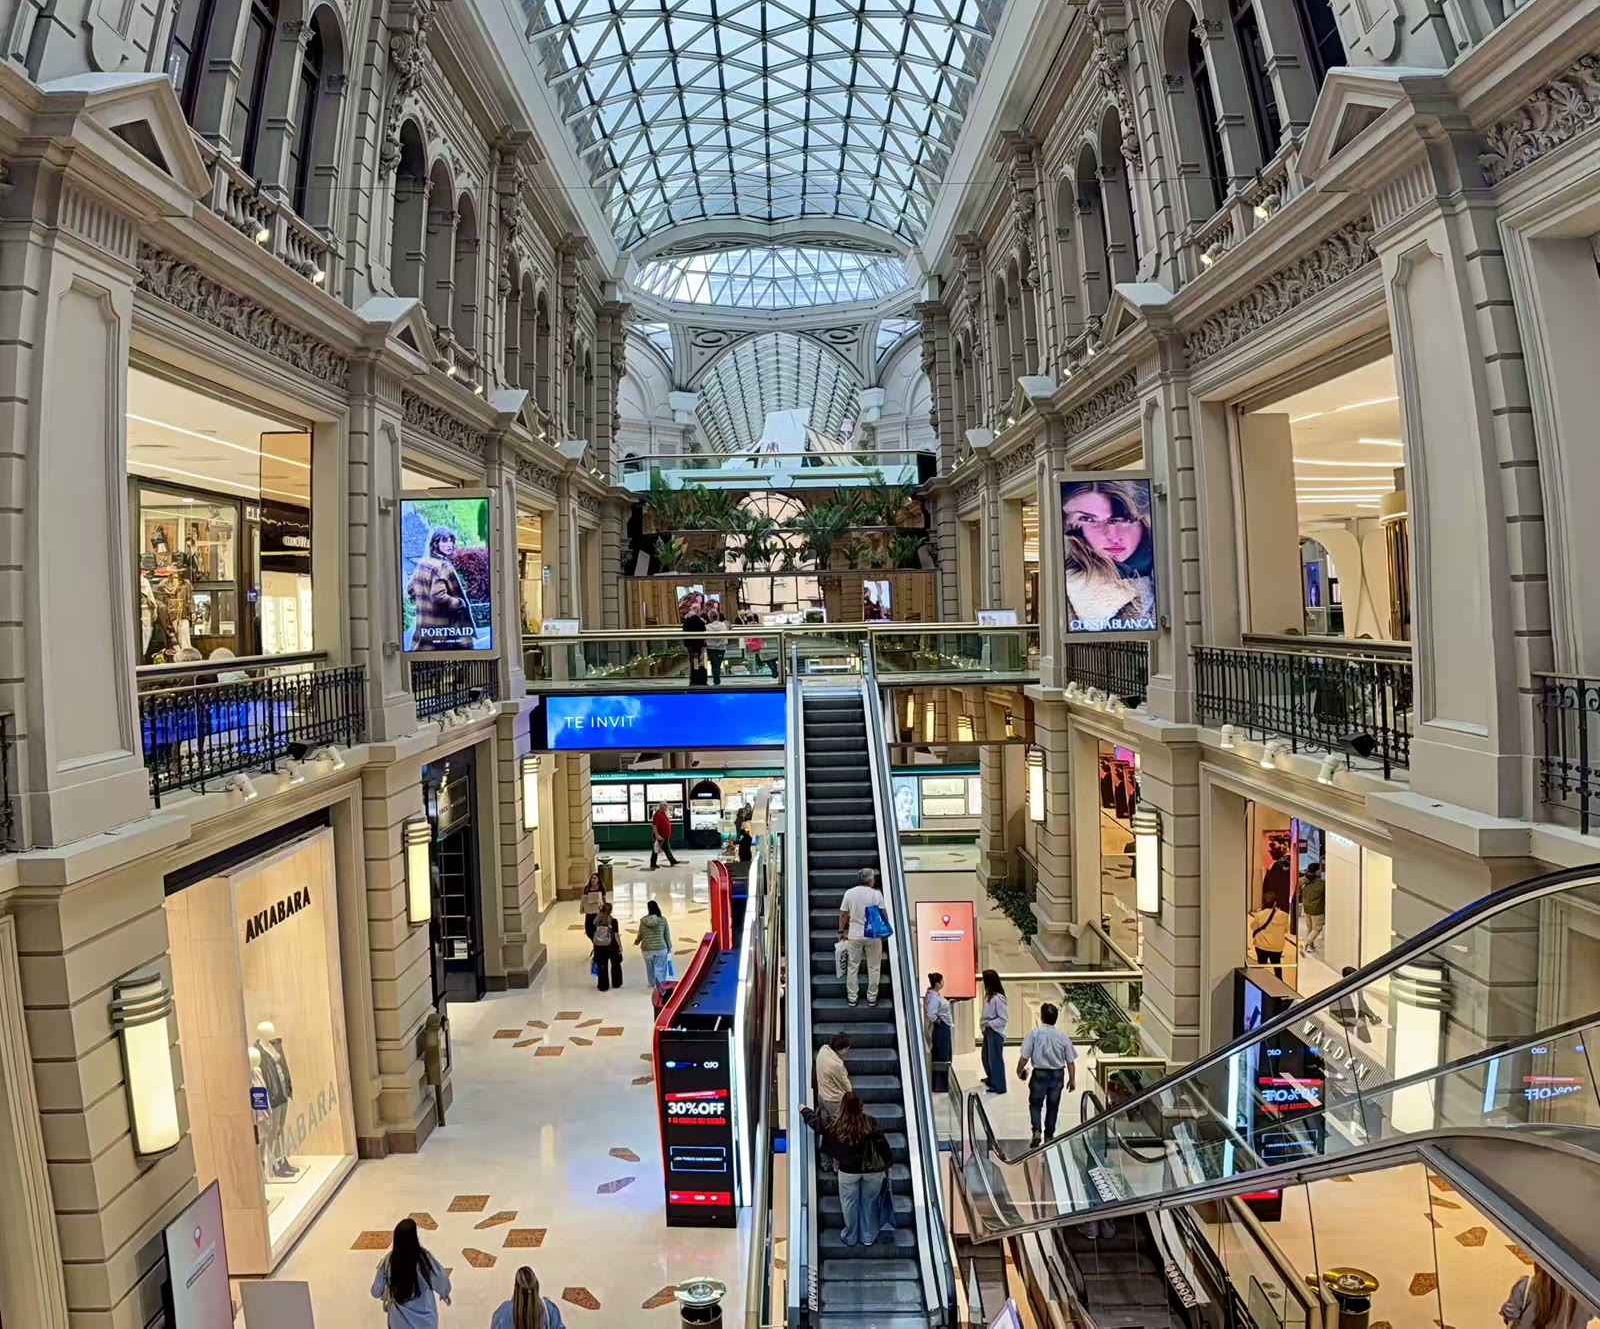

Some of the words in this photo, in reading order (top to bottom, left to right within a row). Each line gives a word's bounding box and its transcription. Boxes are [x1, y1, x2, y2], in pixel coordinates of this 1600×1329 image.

[421, 627, 474, 637] PORTSAID
[564, 716, 583, 729] TE
[245, 886, 311, 944] AKIABARA
[1302, 1020, 1369, 1080] WALDEN
[667, 1102, 725, 1115] 30%OFF
